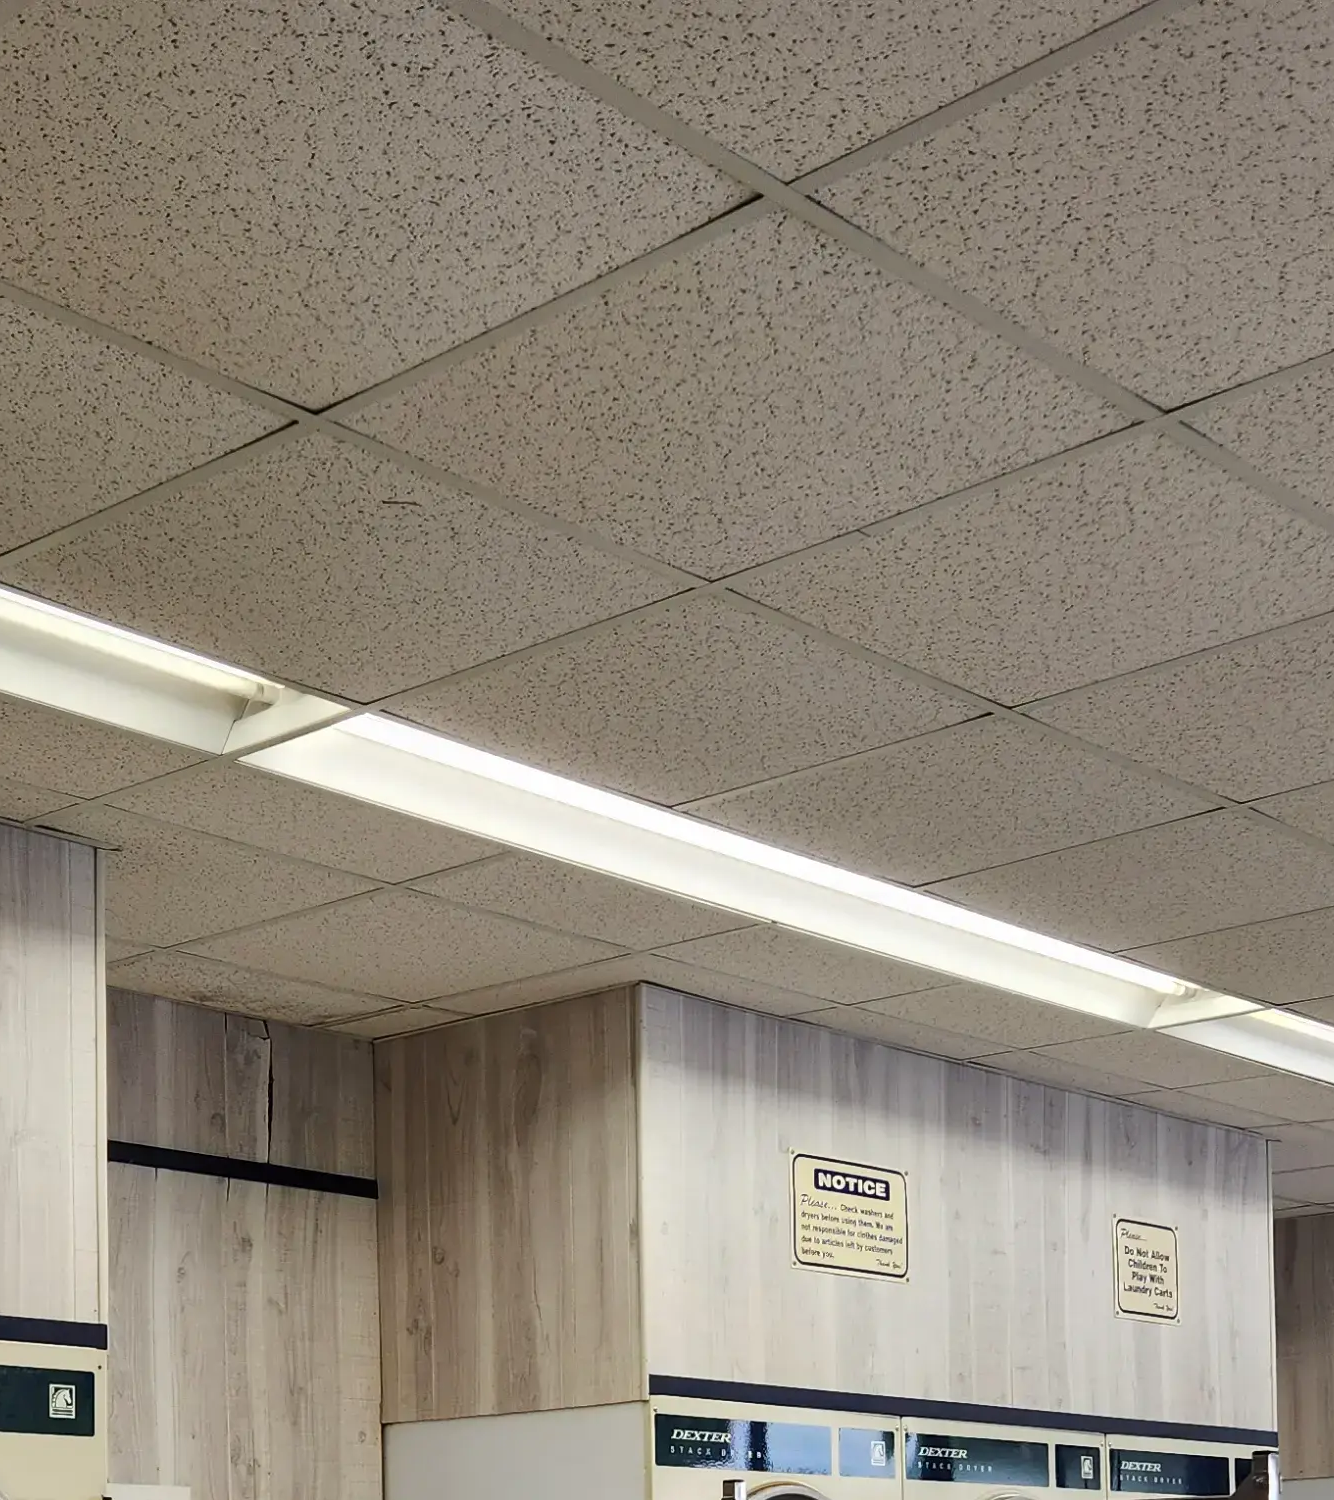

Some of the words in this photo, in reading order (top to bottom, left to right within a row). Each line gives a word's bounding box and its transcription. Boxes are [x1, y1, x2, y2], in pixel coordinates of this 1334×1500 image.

[818, 1172, 886, 1197] NOTICE
[801, 1210, 819, 1220] dryers
[821, 1213, 839, 1223] before
[840, 1204, 858, 1213] Check
[860, 1209, 883, 1218] washers
[813, 1225, 846, 1235] responsible
[857, 1231, 877, 1241] clothes
[801, 1247, 820, 1256] before
[1125, 1246, 1134, 1255] Do
[1136, 1247, 1148, 1258] Not
[1151, 1250, 1169, 1261] Allow
[1128, 1259, 1157, 1271] Children
[1159, 1264, 1167, 1273] To
[1132, 1271, 1147, 1283] Play
[1149, 1274, 1164, 1285] With
[1124, 1281, 1152, 1297] Laundry
[1154, 1287, 1172, 1298] Carts
[671, 1429, 731, 1443] DEXTER
[918, 1446, 967, 1458] DEXTER
[1120, 1461, 1161, 1472] DEXTER
